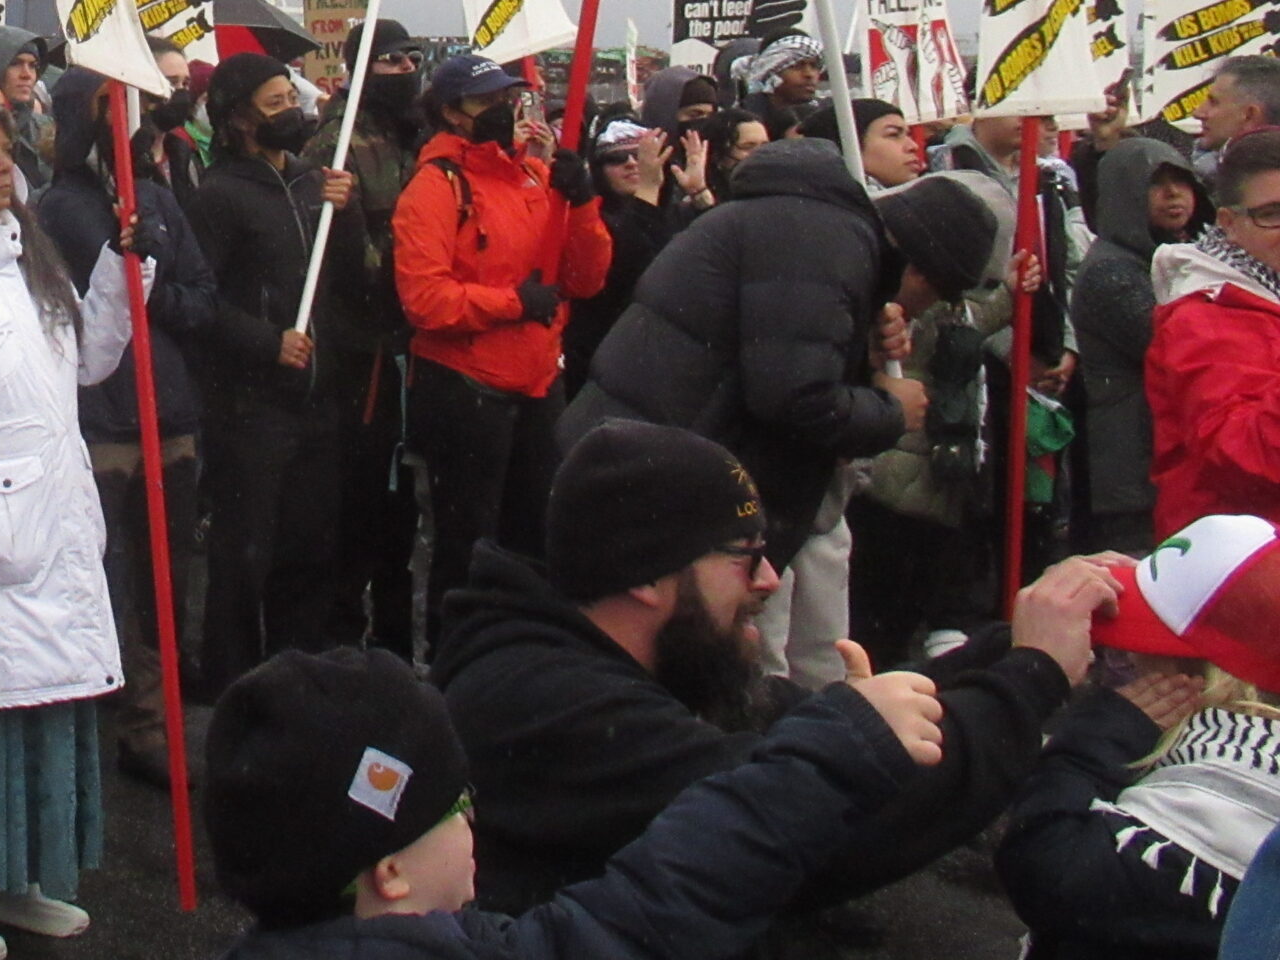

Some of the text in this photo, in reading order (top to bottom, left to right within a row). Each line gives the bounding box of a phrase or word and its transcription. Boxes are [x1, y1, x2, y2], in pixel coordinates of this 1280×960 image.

[140, 1, 169, 28] KIDS
[684, 0, 718, 18] can't
[312, 19, 344, 34] FROM
[475, 25, 491, 46] NO
[689, 19, 749, 38] the poor.
[1175, 14, 1199, 39] US
[316, 41, 342, 60] RIV
[1173, 41, 1208, 68] KILL
[984, 73, 1002, 105] NO
[999, 32, 1043, 88] BOMBS
[1162, 102, 1183, 122] NO
[736, 500, 758, 517] LOC
